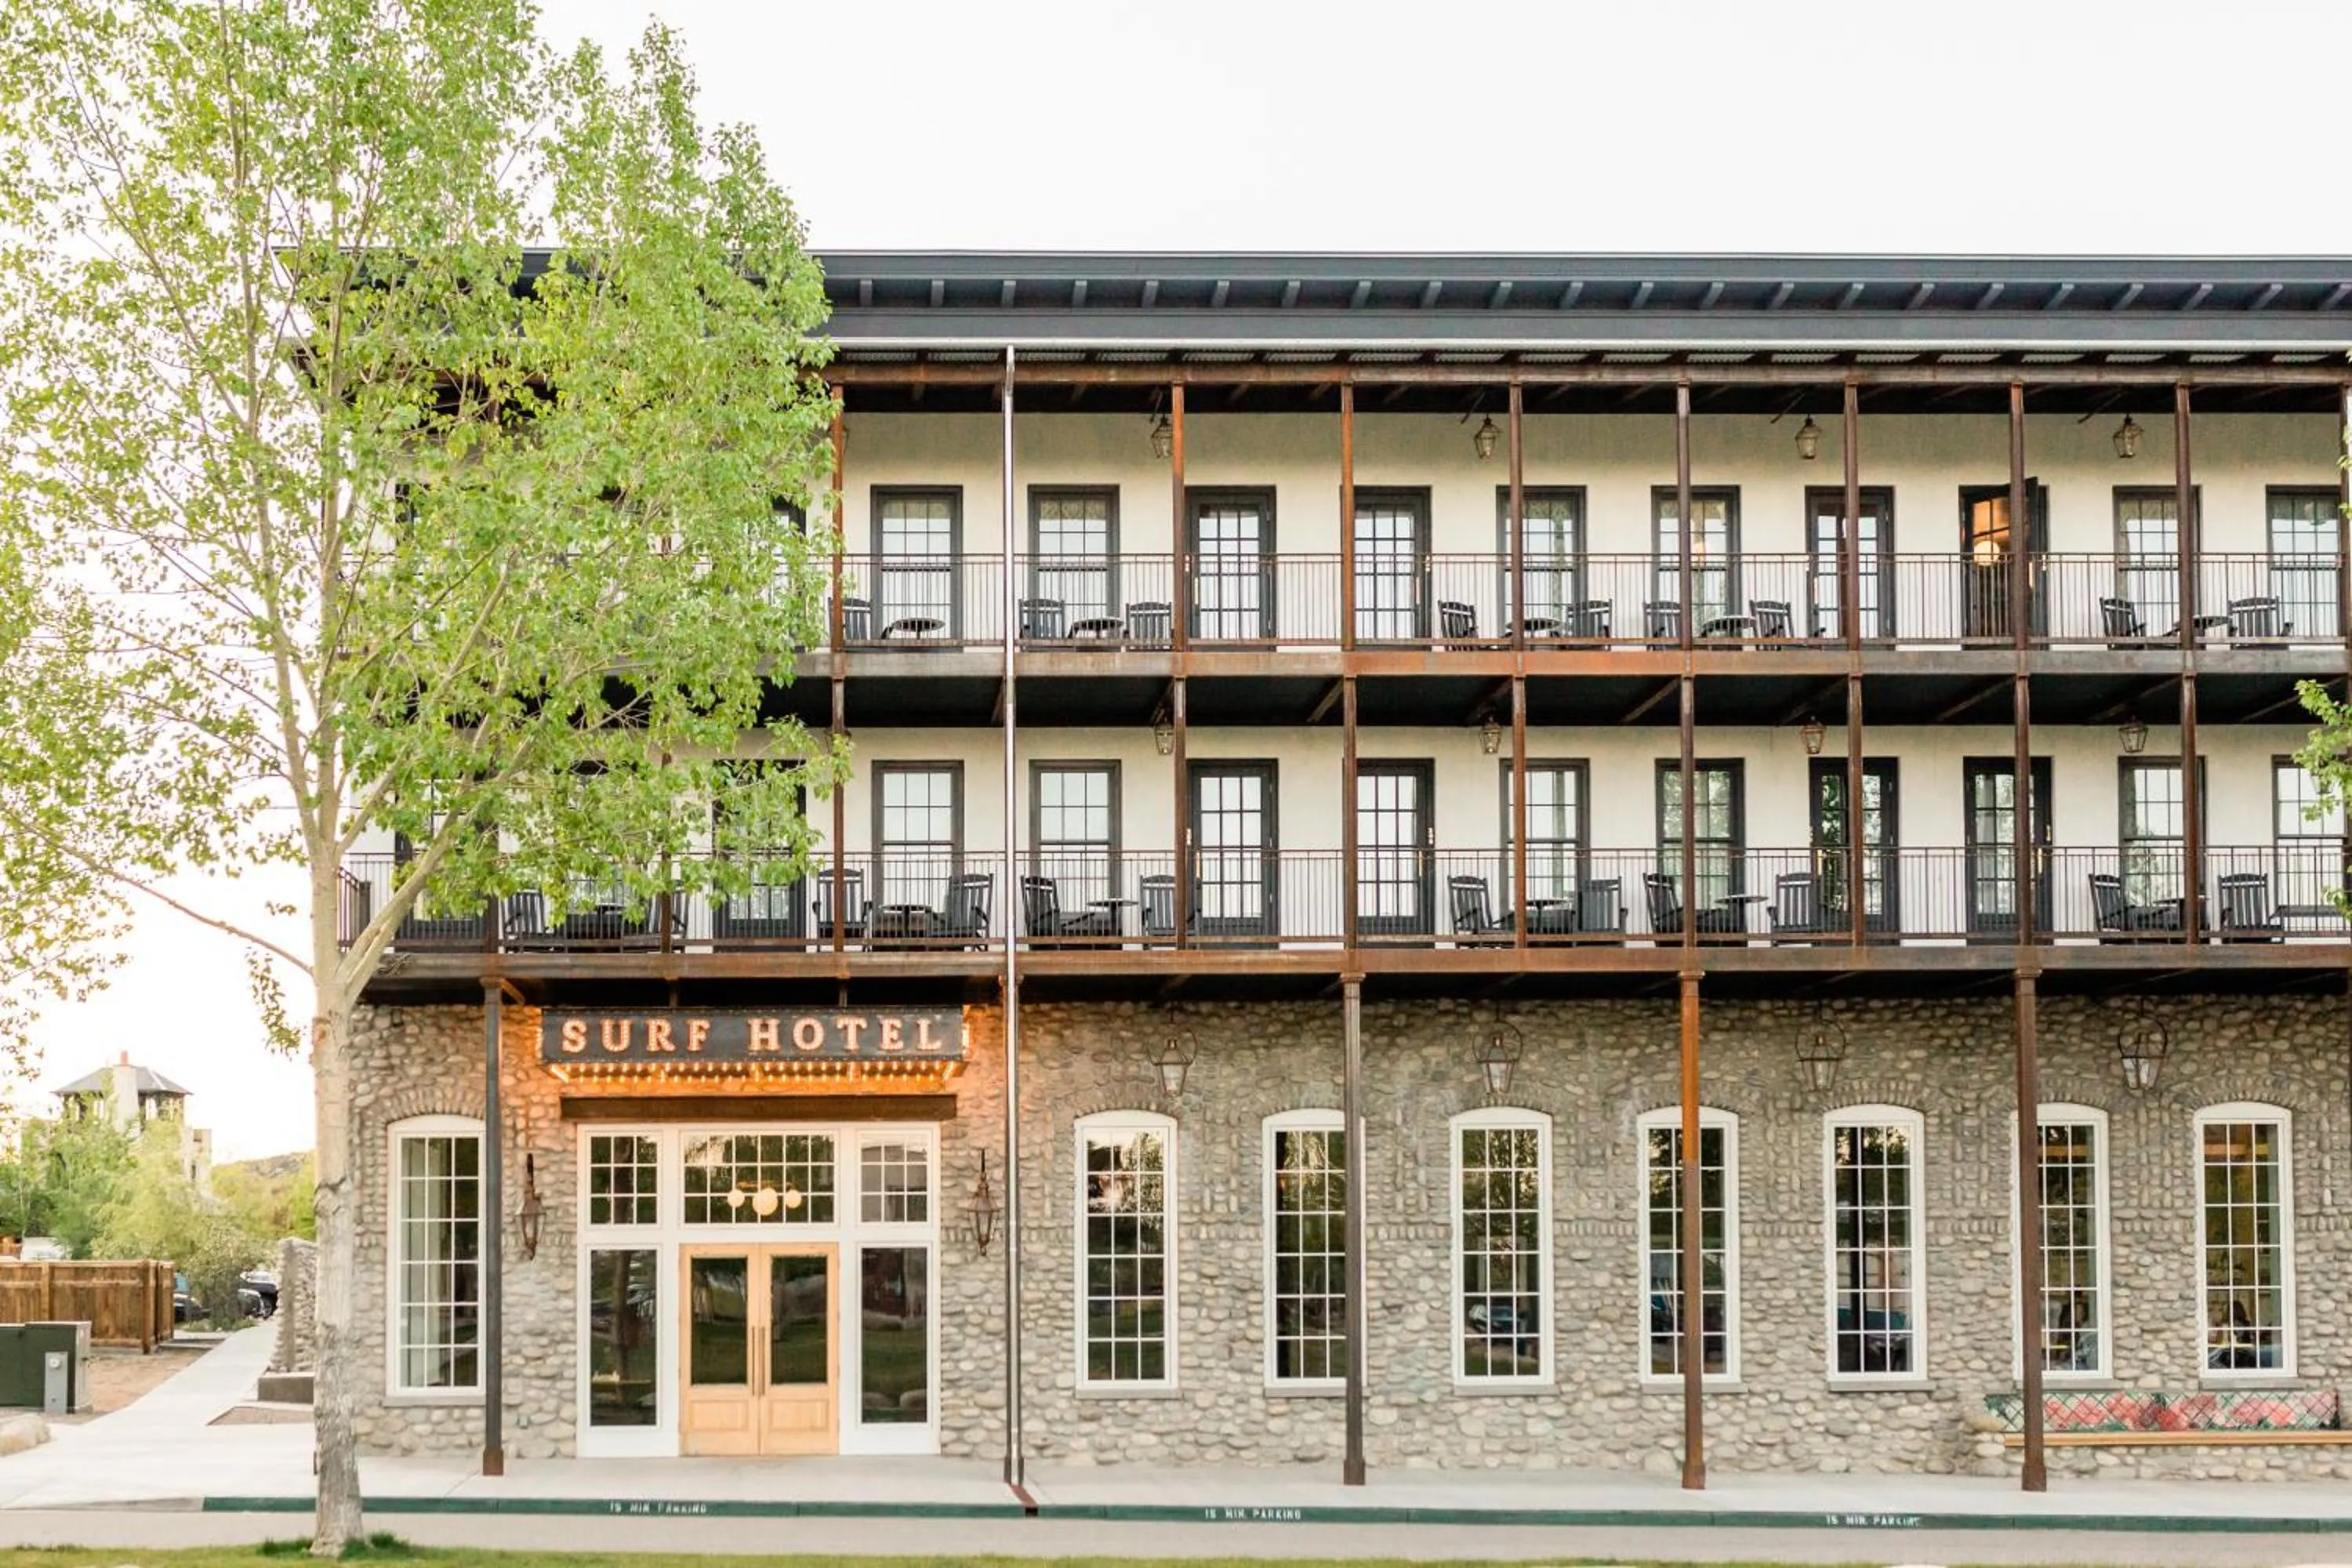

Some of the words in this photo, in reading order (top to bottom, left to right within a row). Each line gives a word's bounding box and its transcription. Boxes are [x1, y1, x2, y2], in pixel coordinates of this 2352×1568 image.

[561, 1018, 711, 1052] SURF
[748, 1018, 942, 1052] HOTEL
[1252, 1508, 1301, 1519] PARKING
[1827, 1514, 1838, 1525] 15
